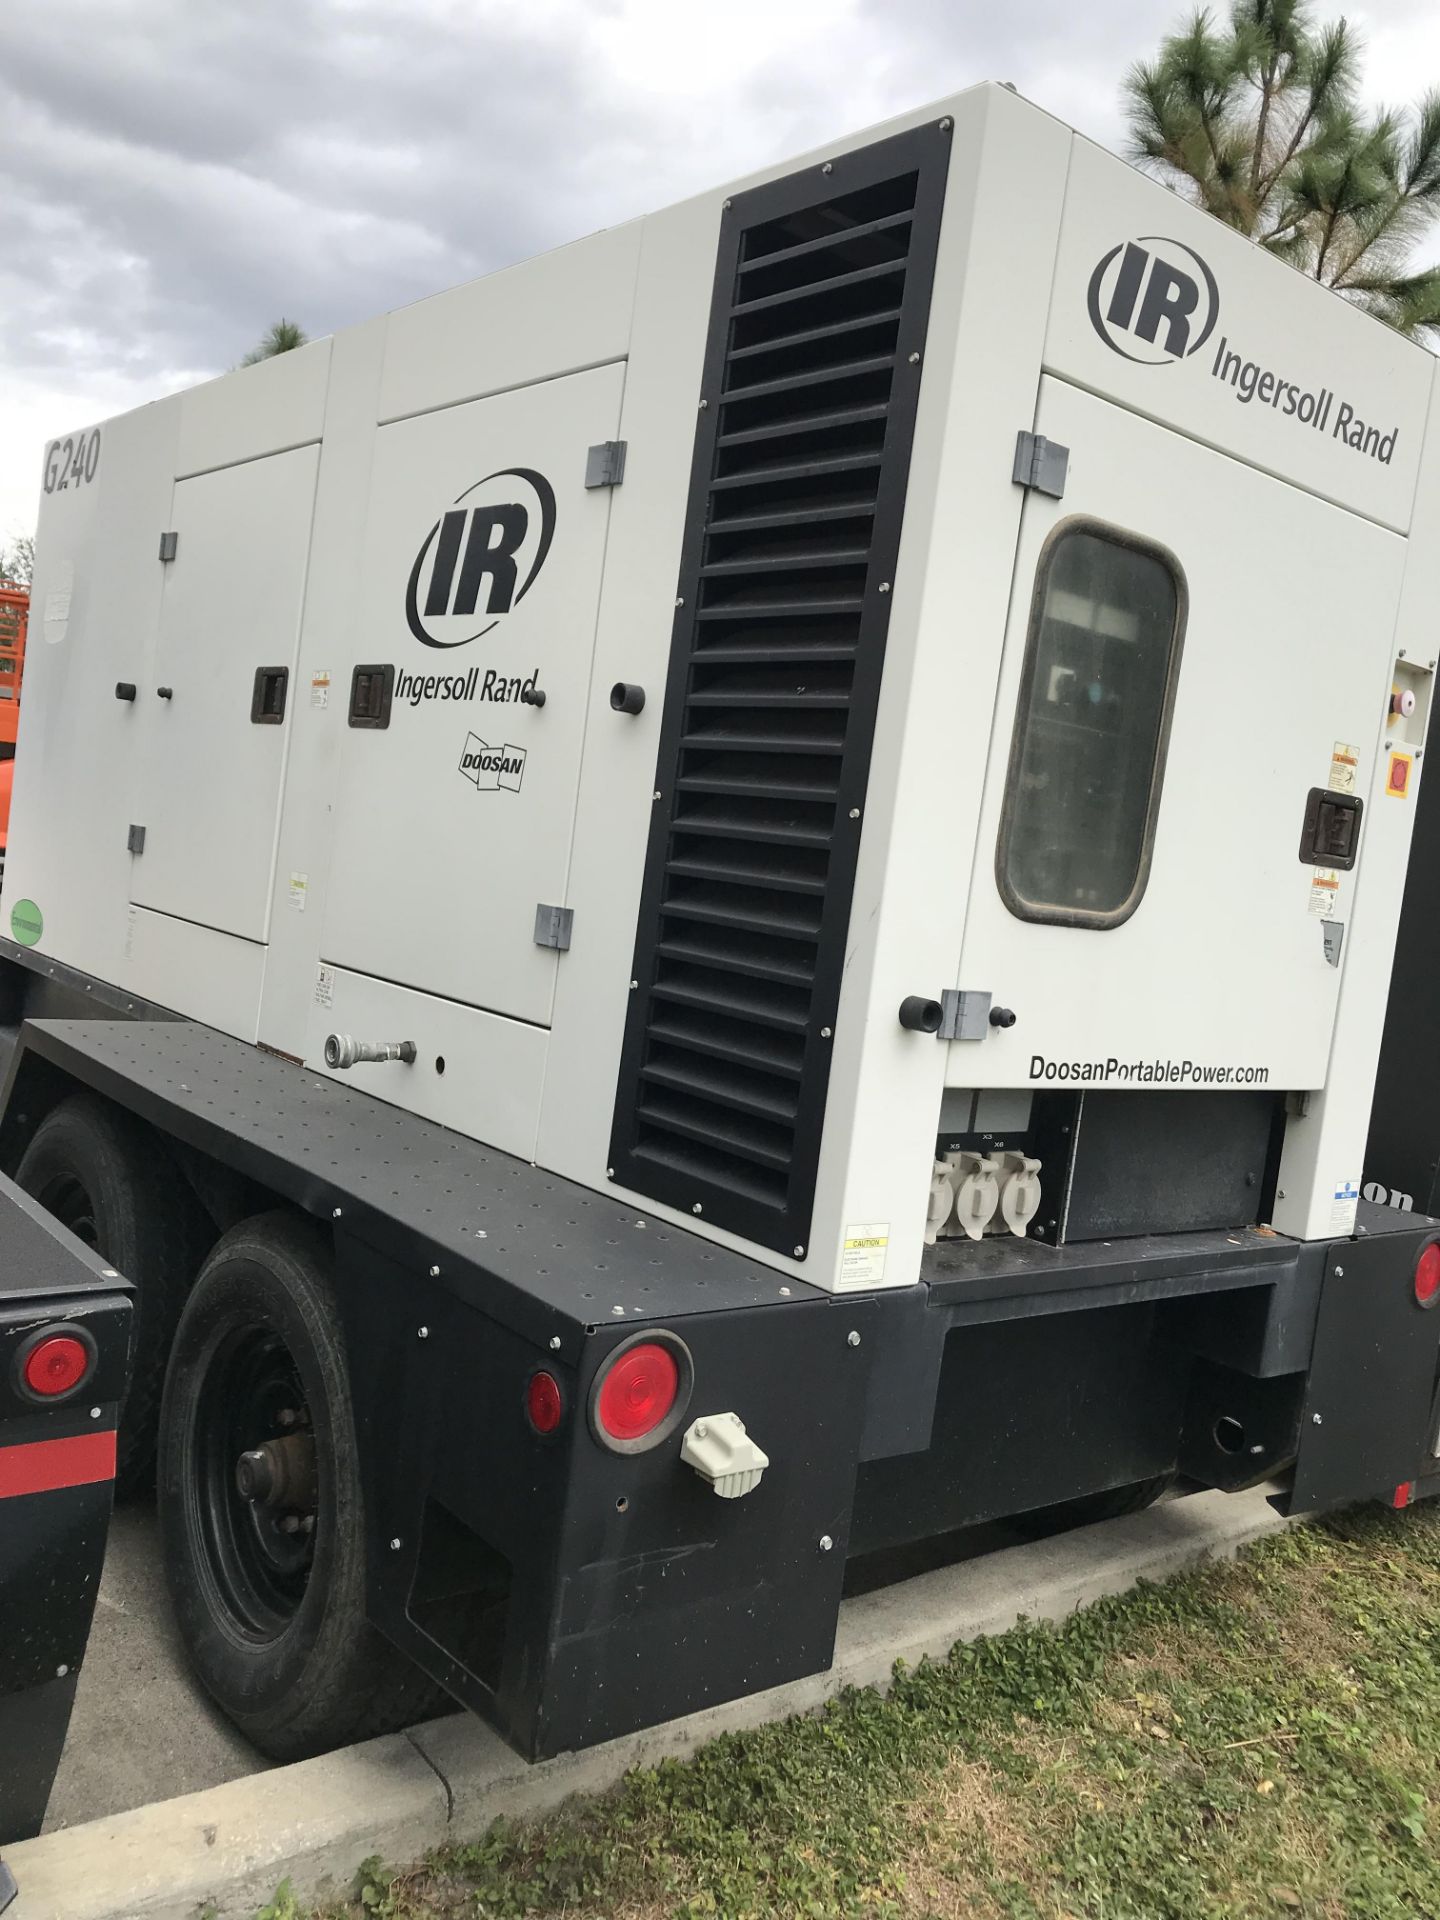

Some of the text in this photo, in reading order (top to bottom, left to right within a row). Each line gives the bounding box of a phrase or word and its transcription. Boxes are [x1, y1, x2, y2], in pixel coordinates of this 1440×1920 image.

[1106, 241, 1200, 359] IR
[1211, 336, 1399, 465] Ingersoll Rand
[44, 428, 101, 494] G240
[423, 503, 529, 616] IR
[395, 667, 540, 706] Ingersoll Rand
[462, 753, 523, 774] DOOSAN
[1029, 1055, 1270, 1083] DoosanPortablePower.com
[1359, 1182, 1414, 1212] on
[853, 1239, 880, 1248] CAUTION
